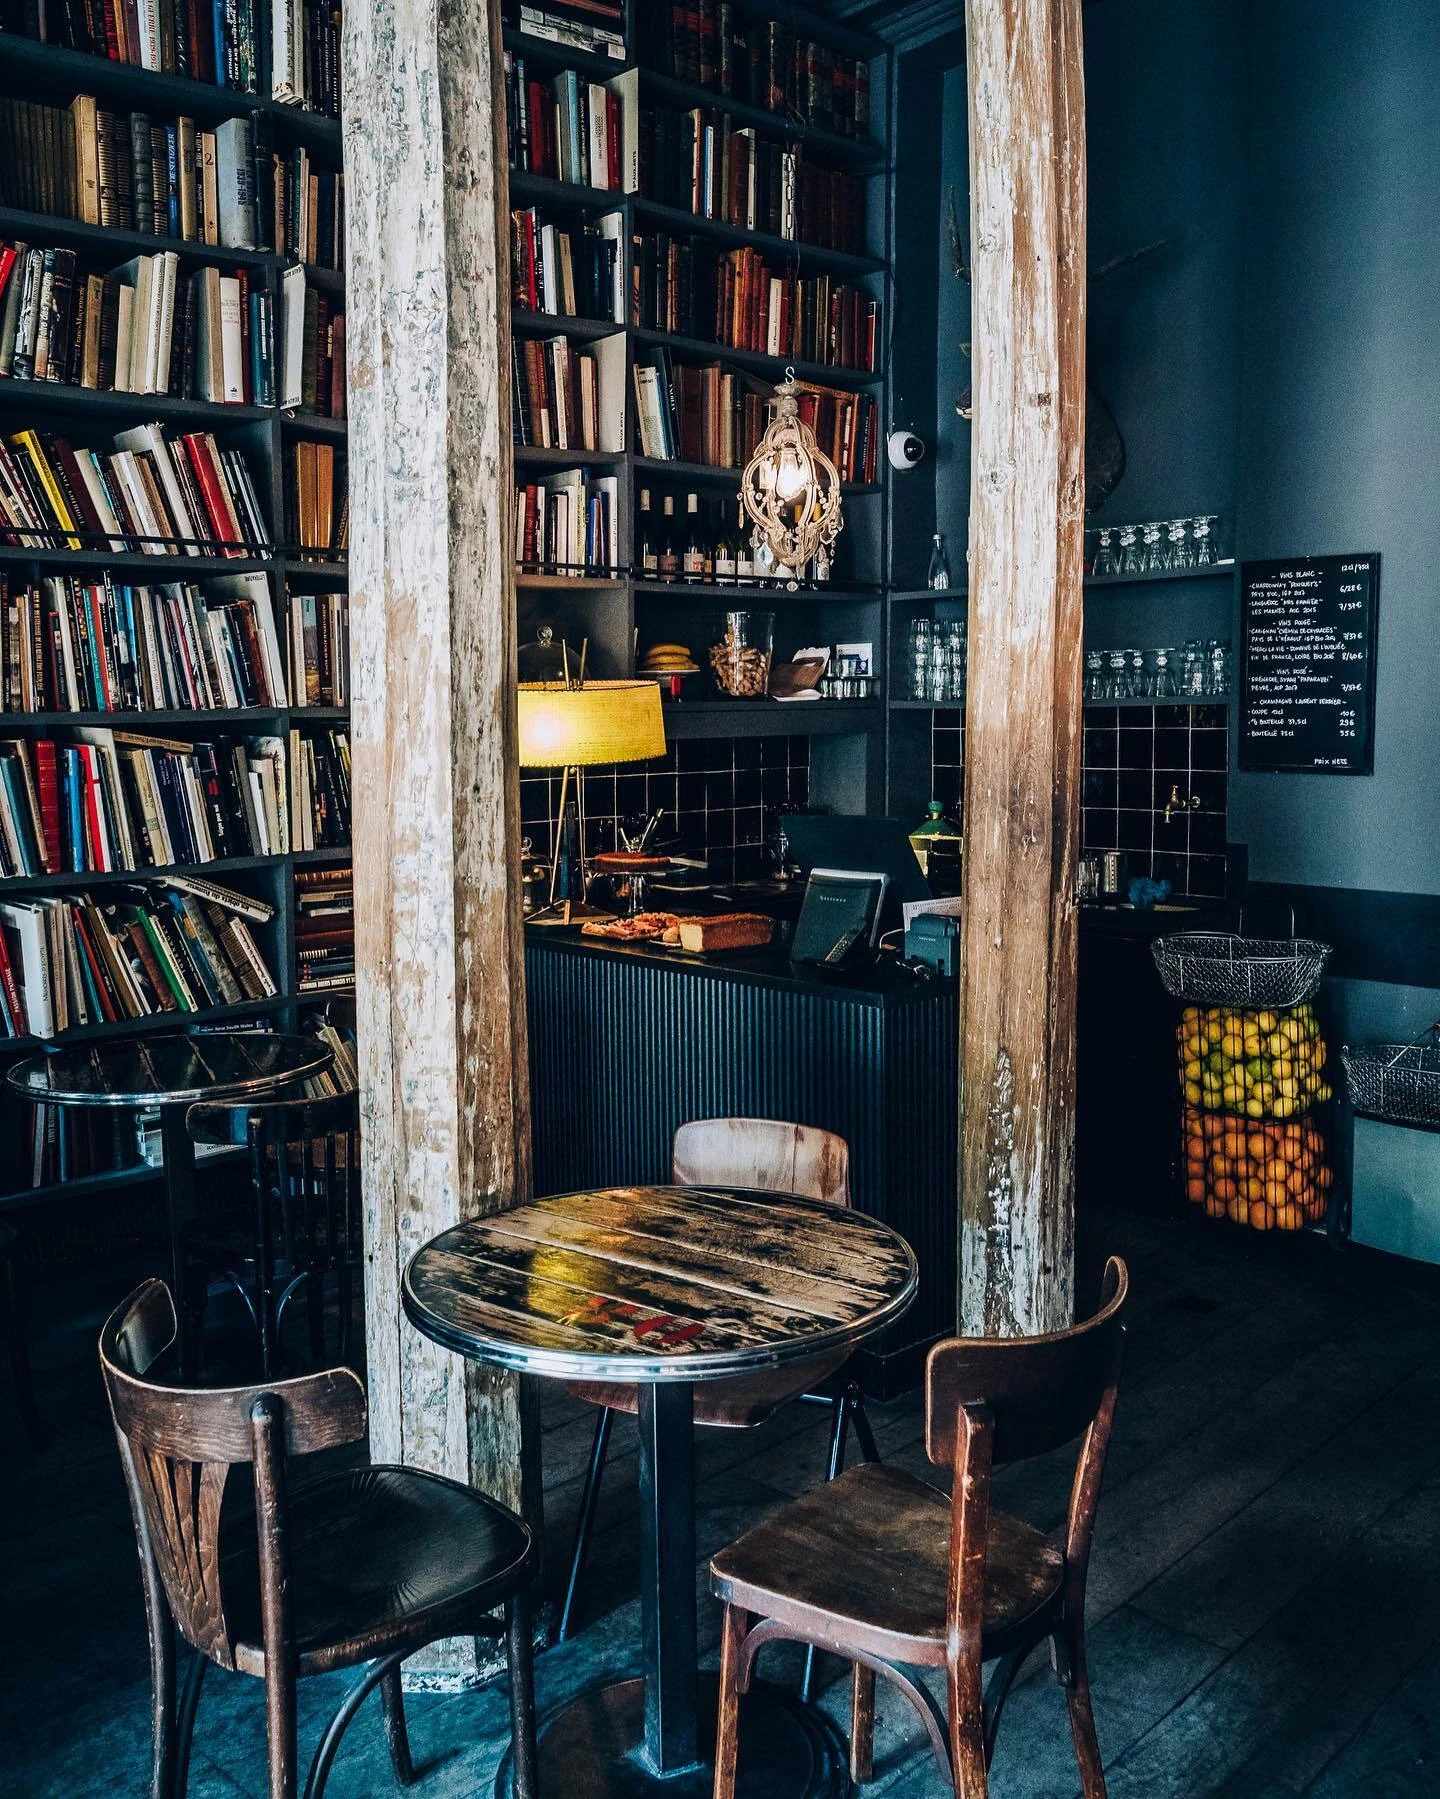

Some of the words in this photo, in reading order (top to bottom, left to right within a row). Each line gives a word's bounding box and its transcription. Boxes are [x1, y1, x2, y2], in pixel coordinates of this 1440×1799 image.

[236, 168, 246, 205] 1939-1945
[39, 306, 49, 320] des
[38, 322, 47, 351] Histoire
[1314, 757, 1330, 765] PRIX
[186, 882, 210, 896] fumeur
[221, 897, 240, 907] objets
[10, 991, 20, 1013] PASSION
